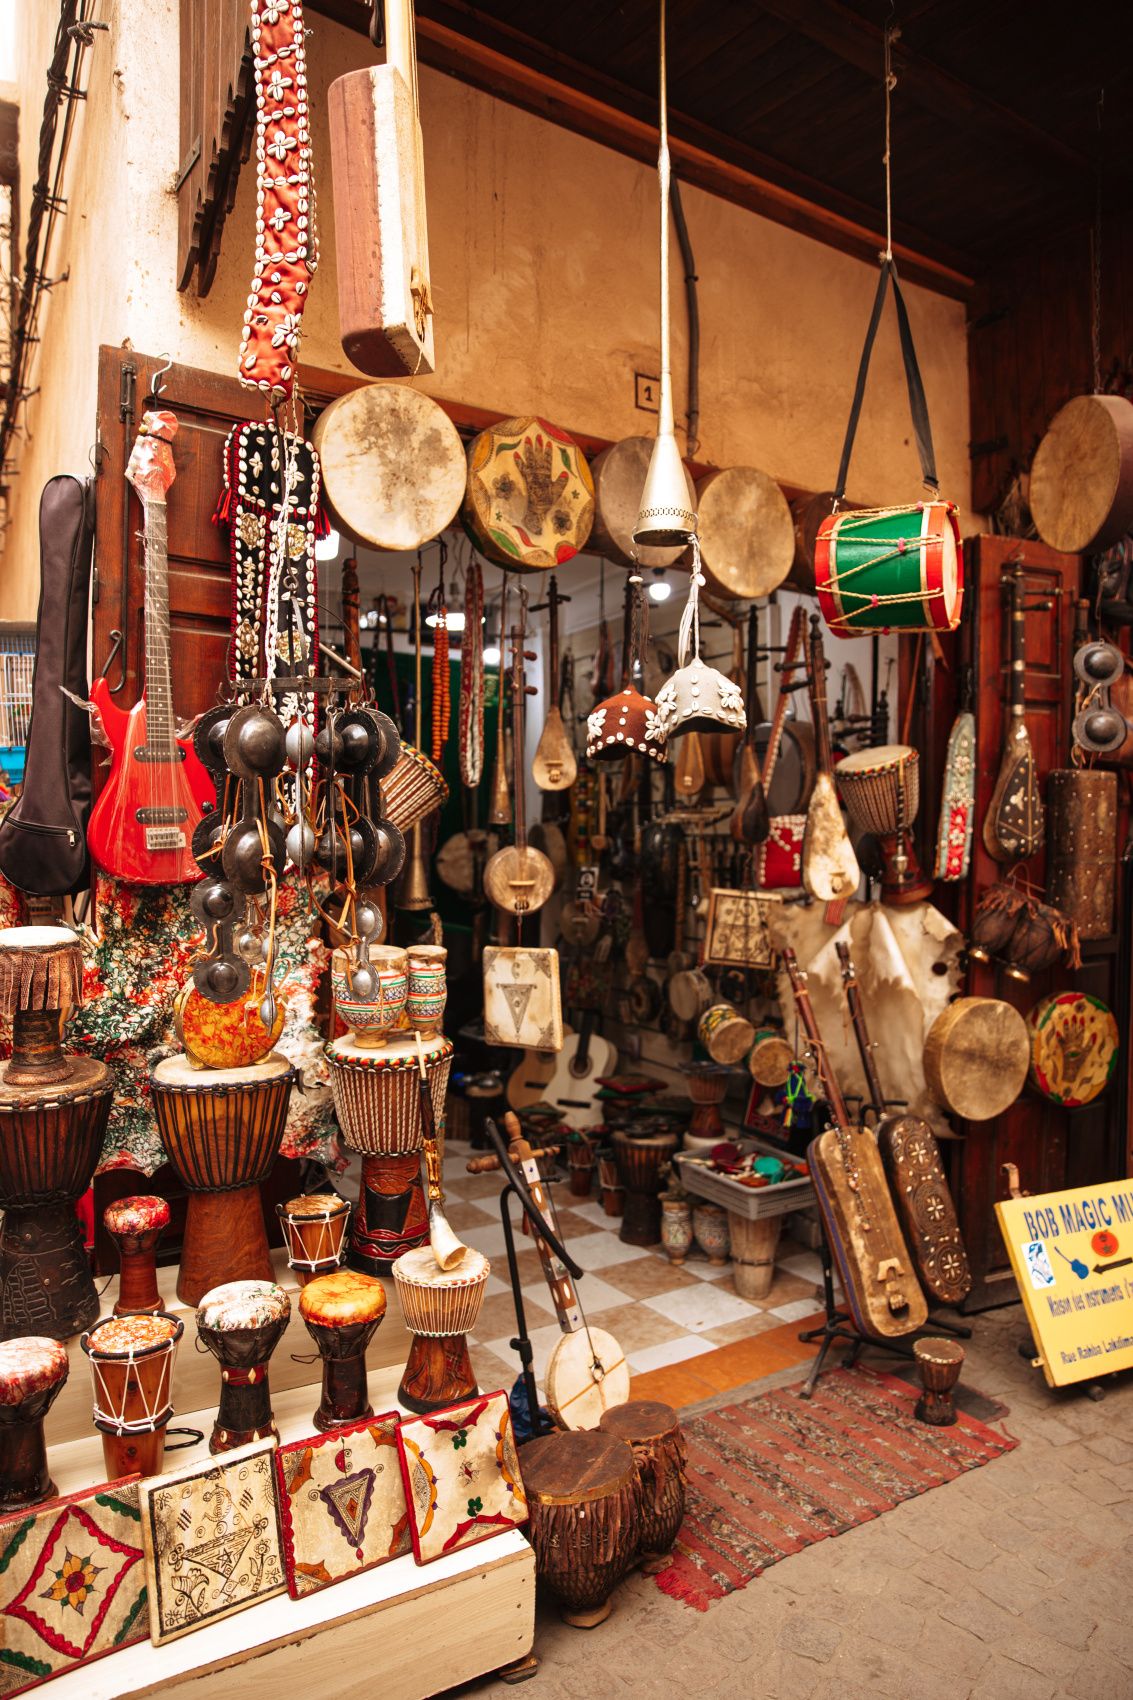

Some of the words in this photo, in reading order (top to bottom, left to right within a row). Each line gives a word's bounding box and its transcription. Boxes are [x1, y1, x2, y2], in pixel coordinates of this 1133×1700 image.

[644, 385, 653, 402] 1
[1023, 1207, 1060, 1242] BOB
[1059, 1197, 1112, 1235] MAGIC
